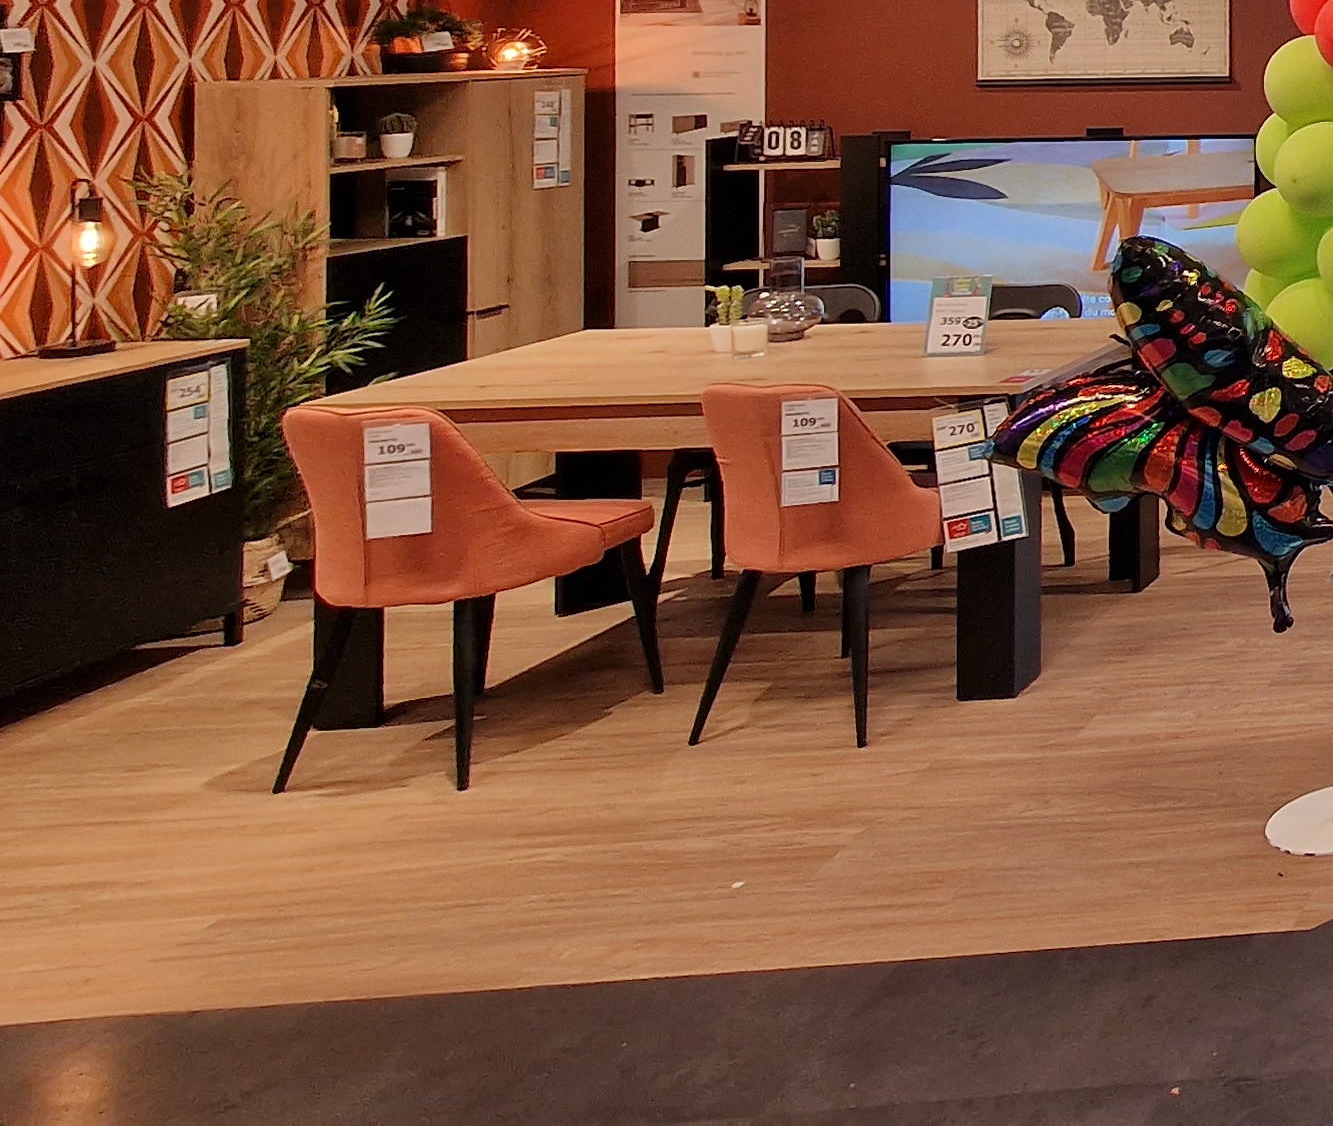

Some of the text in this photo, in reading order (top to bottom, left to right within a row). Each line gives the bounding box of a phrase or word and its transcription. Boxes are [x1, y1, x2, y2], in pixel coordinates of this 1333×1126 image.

[940, 317, 960, 325] 359
[941, 334, 972, 346] 270
[793, 417, 817, 427] 109
[949, 423, 975, 436] 270
[378, 444, 405, 455] 109
